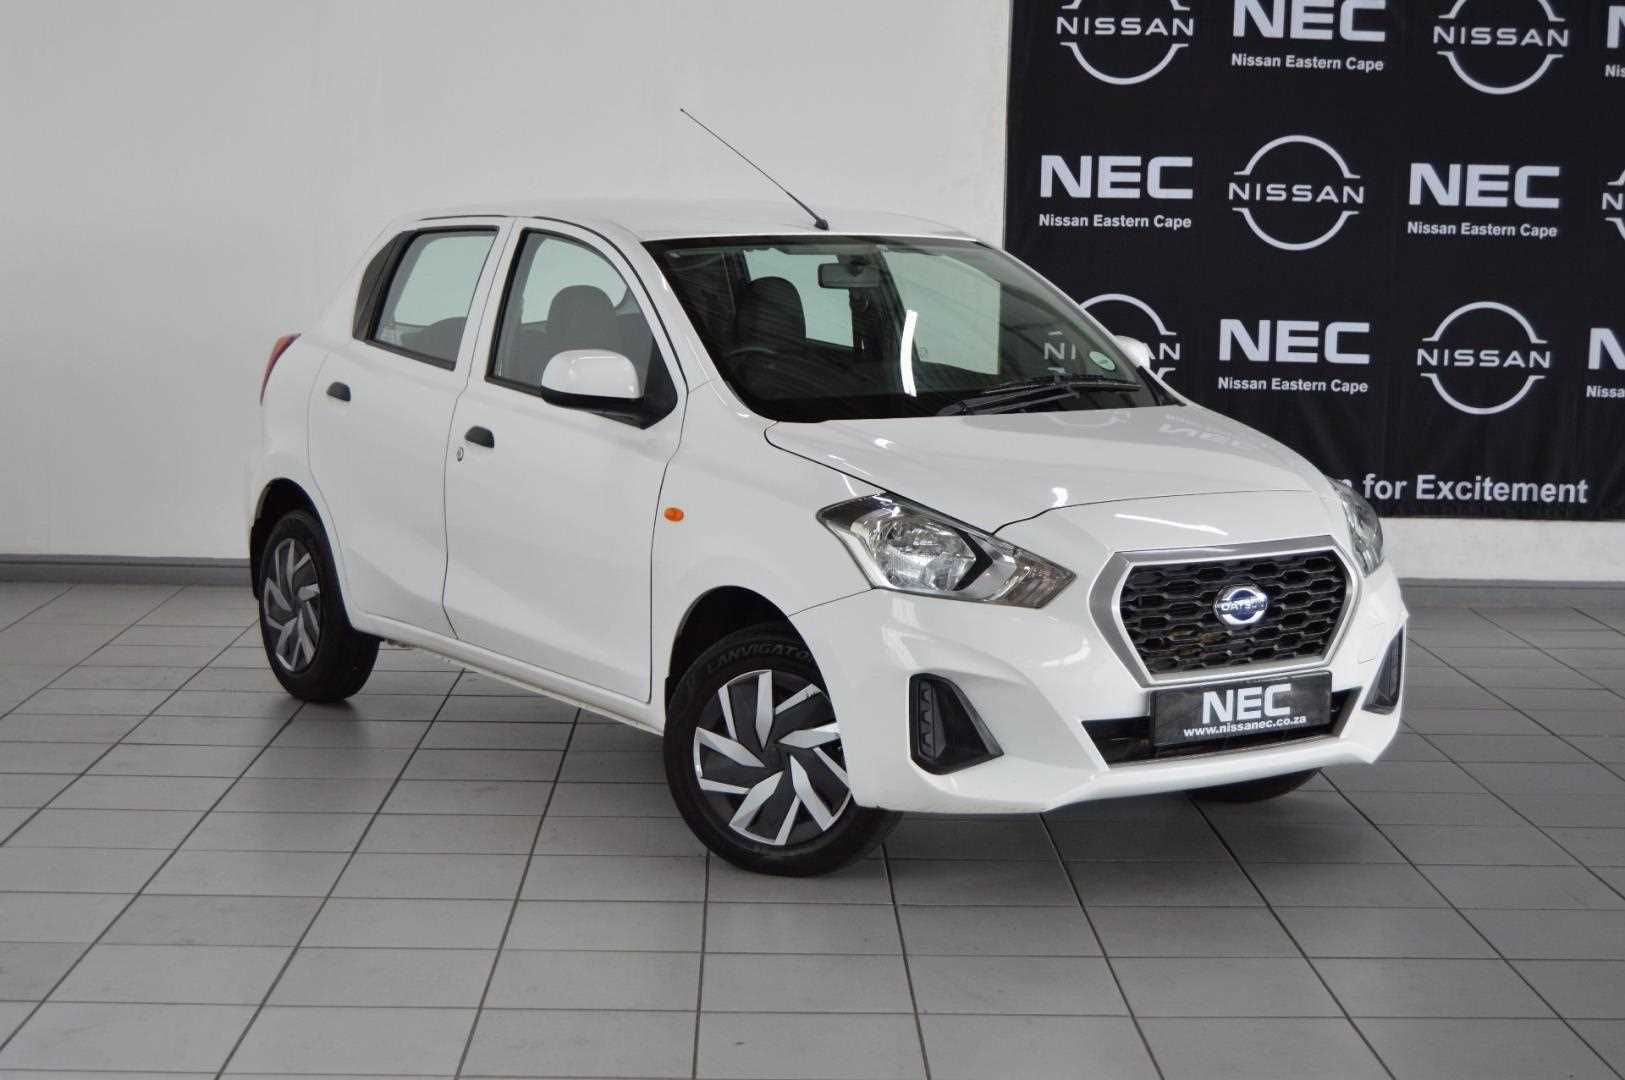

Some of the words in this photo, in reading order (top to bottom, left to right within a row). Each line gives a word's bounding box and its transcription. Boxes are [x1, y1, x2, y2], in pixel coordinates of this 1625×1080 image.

[1057, 17, 1194, 37] NISSAN
[1233, 0, 1386, 42] NEC
[1434, 26, 1568, 47] NISSAN
[1231, 53, 1282, 68] Nissan
[1285, 54, 1342, 70] Eastern
[1345, 56, 1385, 74] Cape
[1040, 155, 1193, 200] NEC
[1409, 163, 1560, 209] NEC
[1229, 182, 1364, 204] NISSAN
[1039, 213, 1089, 227] Nissan
[1092, 214, 1150, 228] Eastern
[1153, 215, 1192, 231] Cape
[1407, 221, 1457, 235] Nissan
[1460, 222, 1517, 237] Eastern
[1519, 223, 1558, 240] Cape
[1219, 318, 1370, 365] NEC
[1417, 348, 1551, 369] NISSAN
[1218, 376, 1267, 390] Nissan
[1271, 377, 1327, 392] Eastern
[1330, 379, 1369, 395] Cape
[1586, 384, 1625, 398] Nissa
[1363, 473, 1407, 500] for
[1415, 474, 1589, 504] Excitement
[1202, 683, 1292, 725] NEC
[1183, 715, 1307, 737] www.nissanec.co.za
